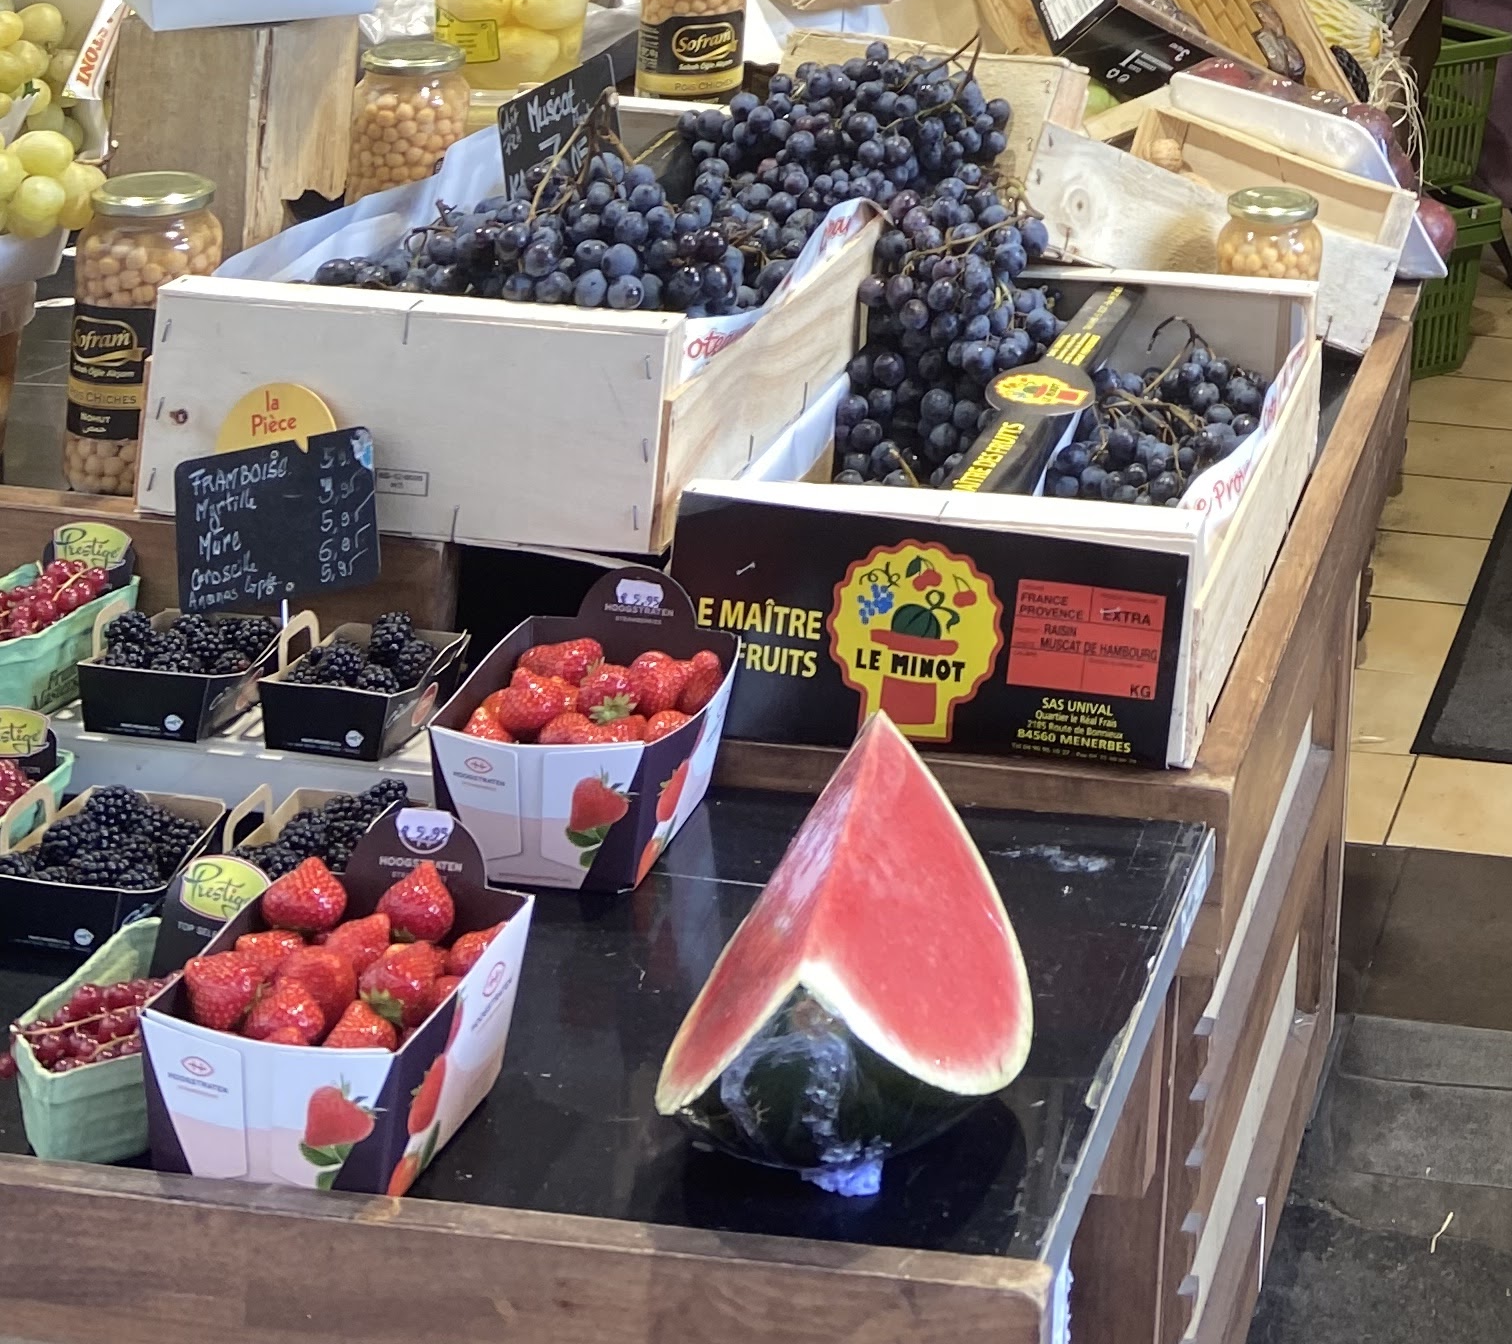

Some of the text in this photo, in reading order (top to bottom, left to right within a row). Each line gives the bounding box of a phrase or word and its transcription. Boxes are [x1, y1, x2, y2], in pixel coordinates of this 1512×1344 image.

[676, 28, 734, 54] Sofram
[72, 327, 132, 352] Sofram
[85, 391, 137, 405] CHICHES
[264, 390, 280, 413] la
[251, 413, 297, 437] Pièce
[55, 527, 122, 569] Prestige
[1020, 591, 1069, 607] FRANCE
[698, 596, 824, 642] E MAÎTRE
[1019, 604, 1152, 627] PROVENCE EXTRA
[1043, 623, 1077, 638] RAISIN
[1040, 637, 1081, 654] MUSCAT
[1083, 641, 1098, 656] DE
[1099, 643, 1158, 662] HAMBOURG
[855, 647, 967, 683] LE MINOT
[1129, 684, 1152, 699] KG
[1034, 710, 1069, 724] Quartier
[1041, 696, 1114, 717] SAS UNIVAL
[1048, 722, 1073, 734] Route
[1073, 725, 1085, 735] de
[1016, 728, 1132, 754] 84560 MENERBES
[378, 855, 464, 874] HOOGSATEN
[182, 861, 251, 918] Prestig
